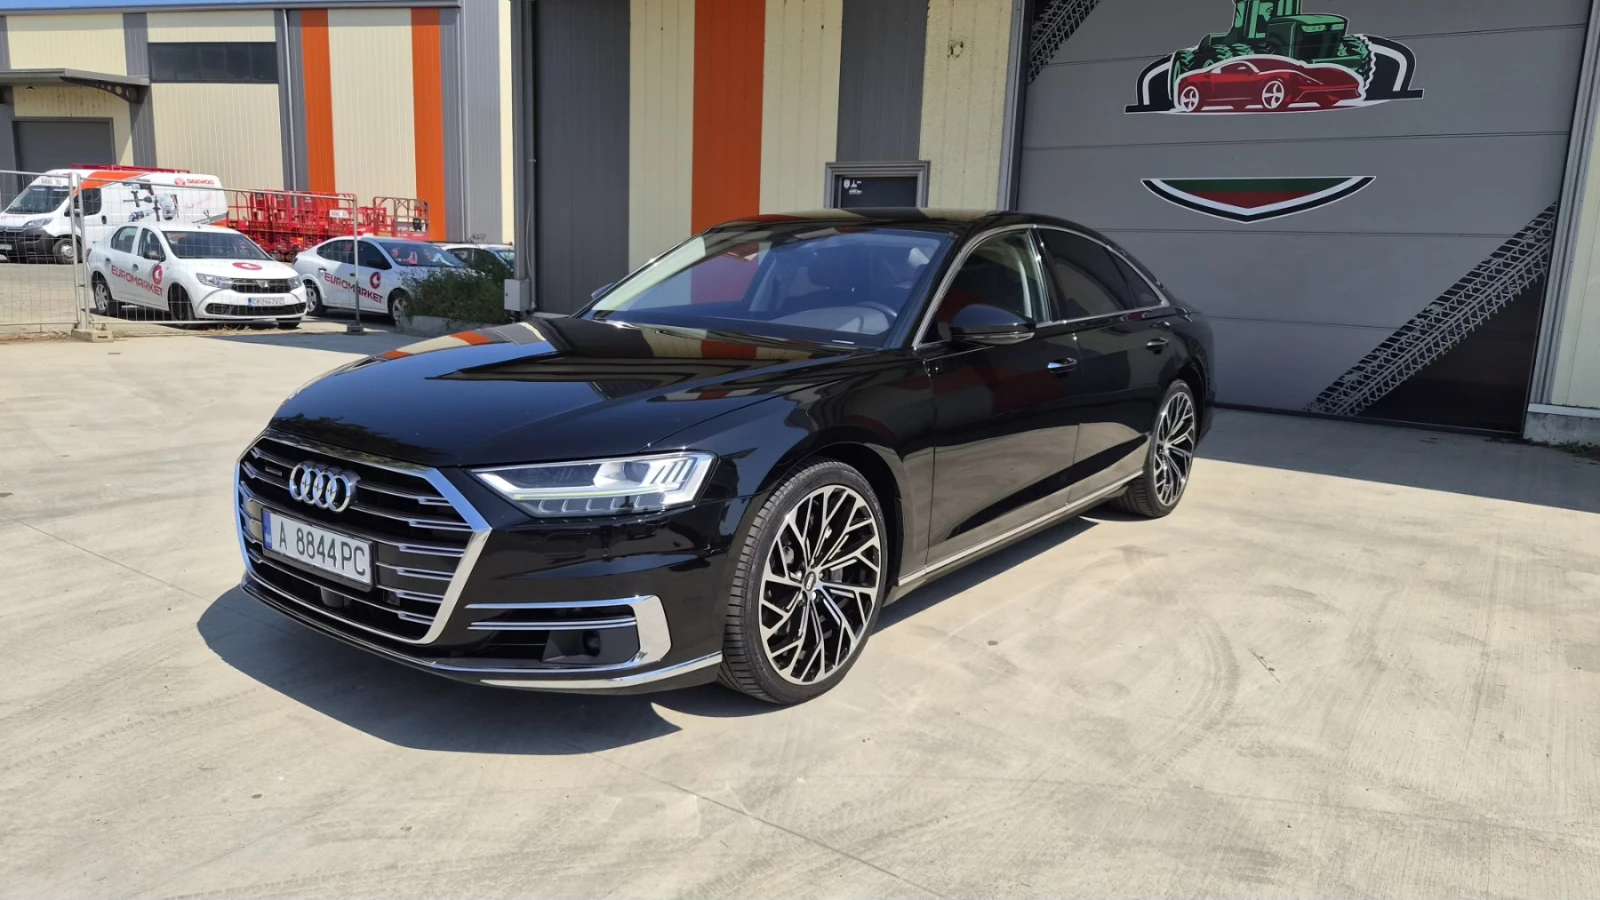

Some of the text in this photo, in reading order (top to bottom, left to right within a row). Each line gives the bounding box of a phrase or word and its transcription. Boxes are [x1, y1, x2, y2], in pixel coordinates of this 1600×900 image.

[111, 264, 163, 297] EUROMARKET
[324, 272, 384, 304] EUROMARKET
[279, 521, 288, 550] A
